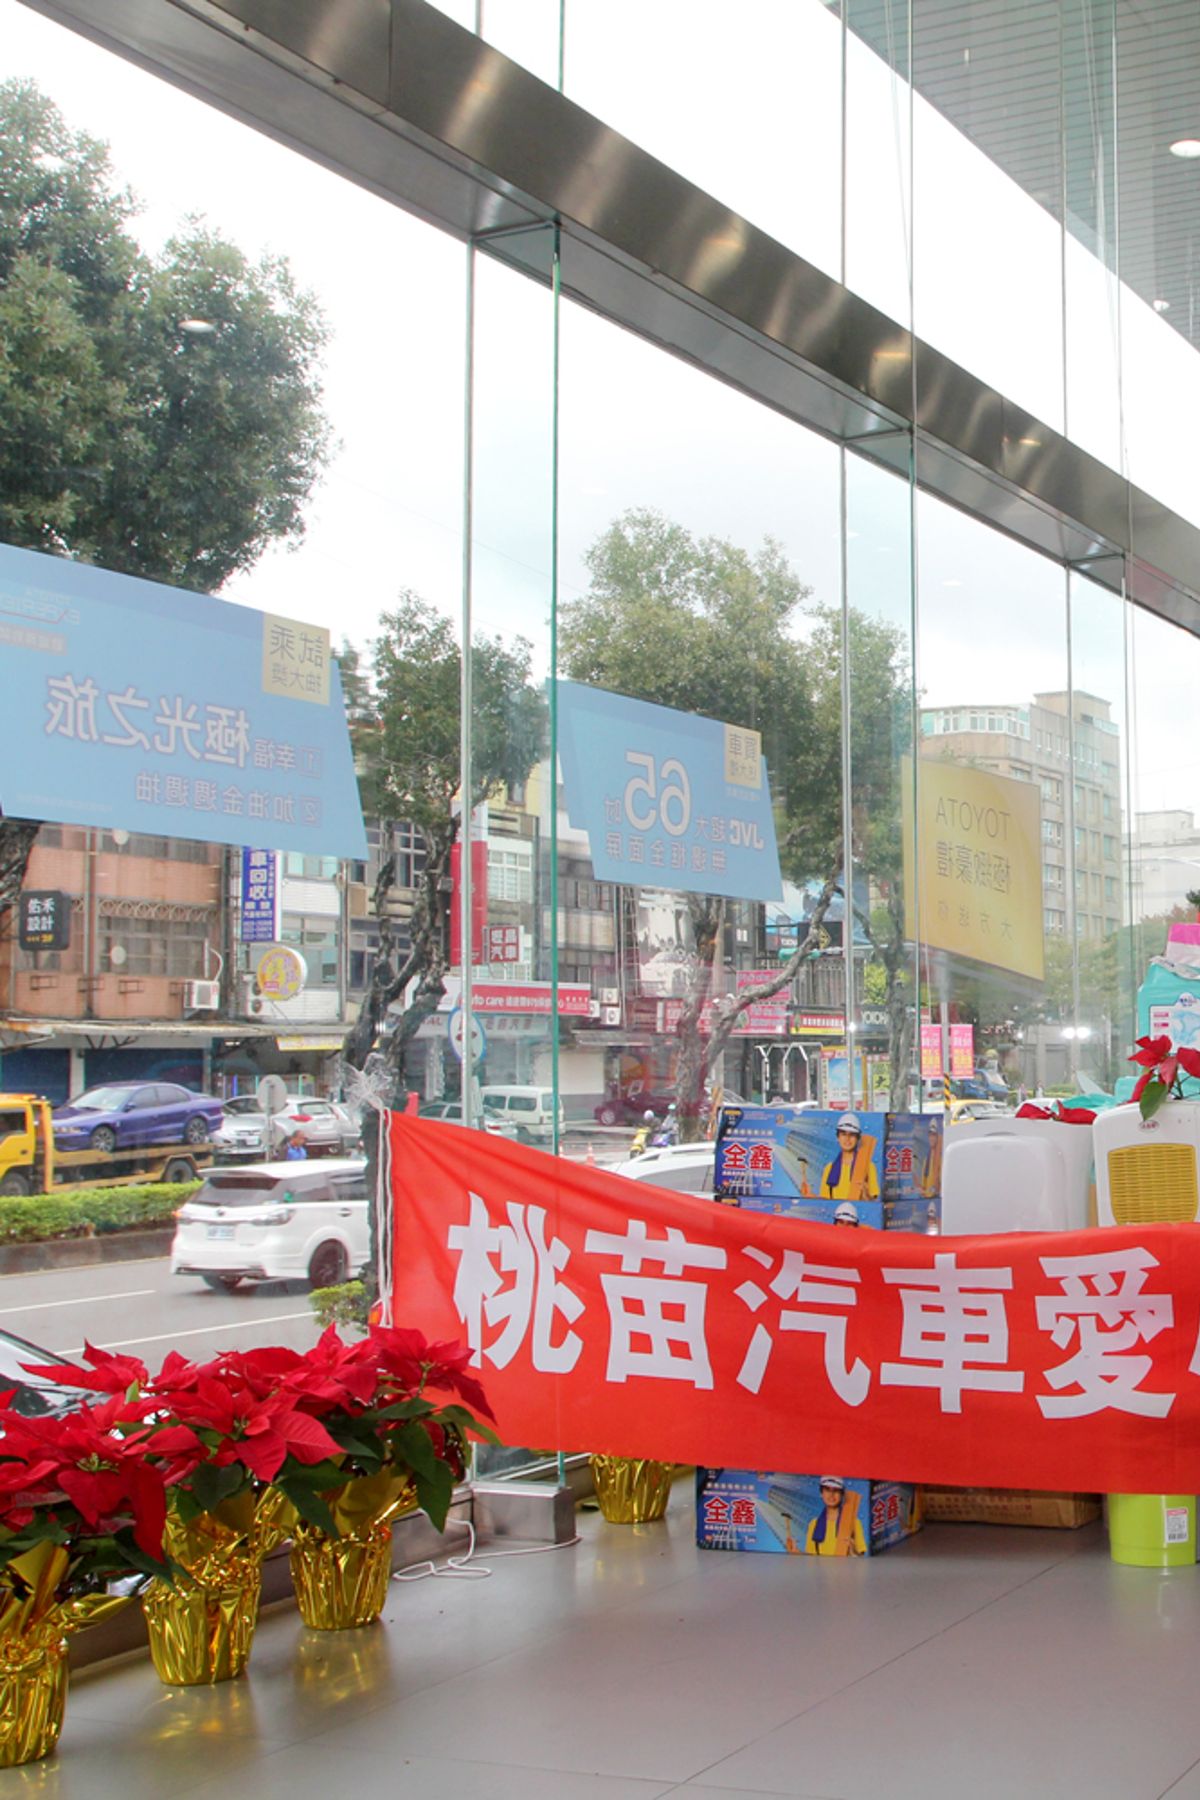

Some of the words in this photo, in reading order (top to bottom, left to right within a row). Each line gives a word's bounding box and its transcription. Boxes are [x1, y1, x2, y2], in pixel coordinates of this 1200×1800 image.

[26, 915, 54, 931] 設計
[722, 1143, 774, 1171] 全鑫
[883, 1146, 913, 1174] 全鑫
[704, 1496, 757, 1527] 全鑫
[872, 1493, 899, 1529] 全鑫
